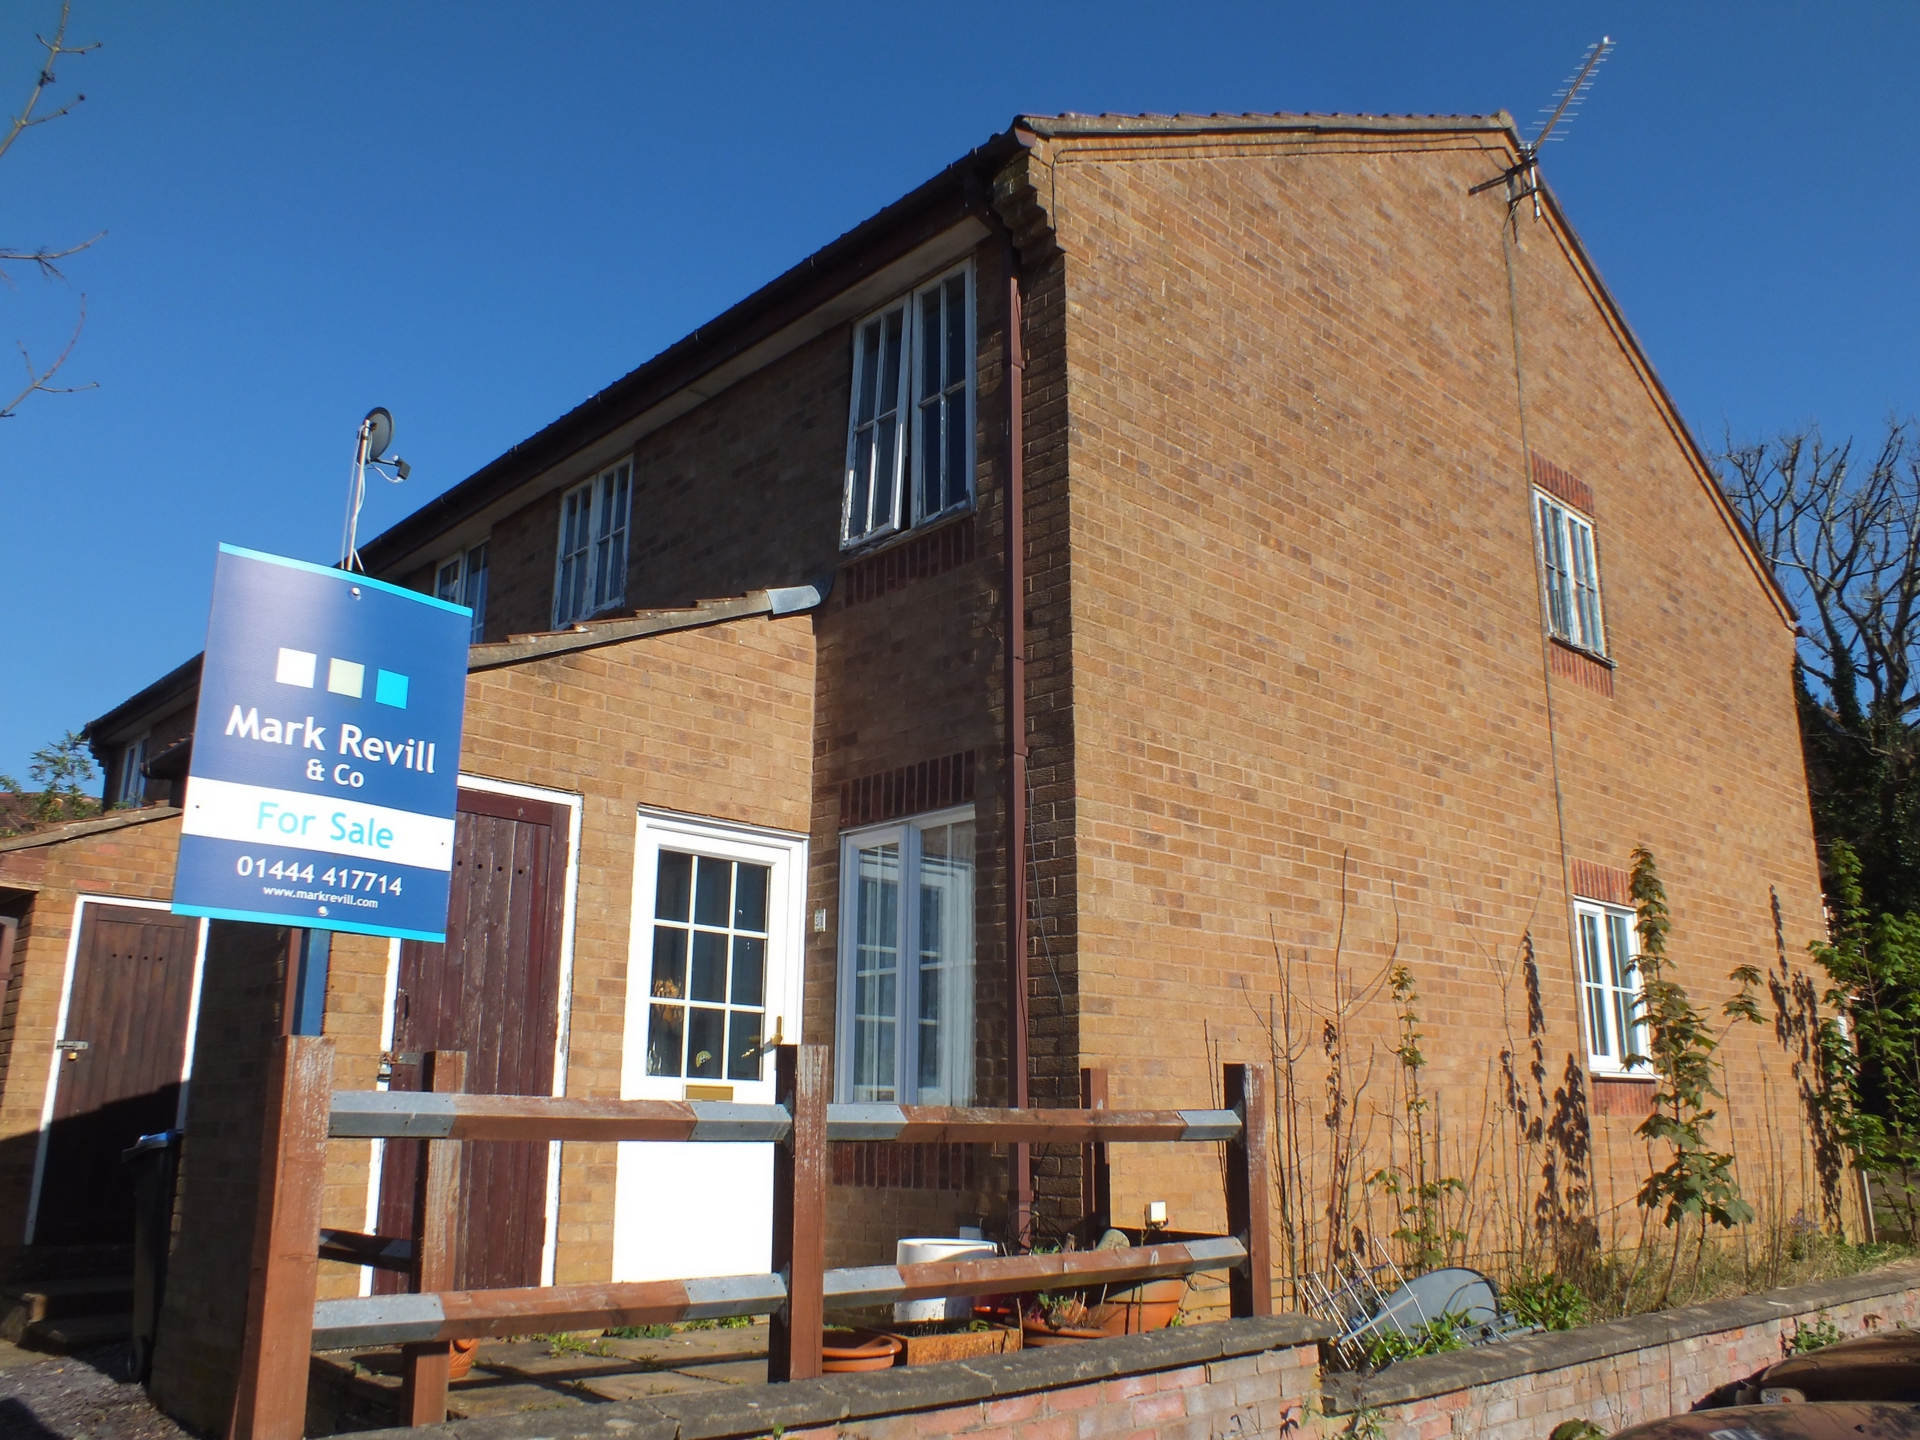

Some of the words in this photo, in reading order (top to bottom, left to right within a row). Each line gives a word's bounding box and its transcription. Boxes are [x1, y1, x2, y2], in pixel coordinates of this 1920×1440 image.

[225, 704, 327, 751] Mark
[339, 723, 437, 774] Revill
[306, 758, 326, 782] &
[333, 762, 366, 789] Co
[256, 800, 317, 836] For
[329, 812, 395, 850] Sale
[236, 855, 316, 884] 01444
[321, 866, 403, 897] 417714
[263, 886, 380, 909] www.markrevill.com
